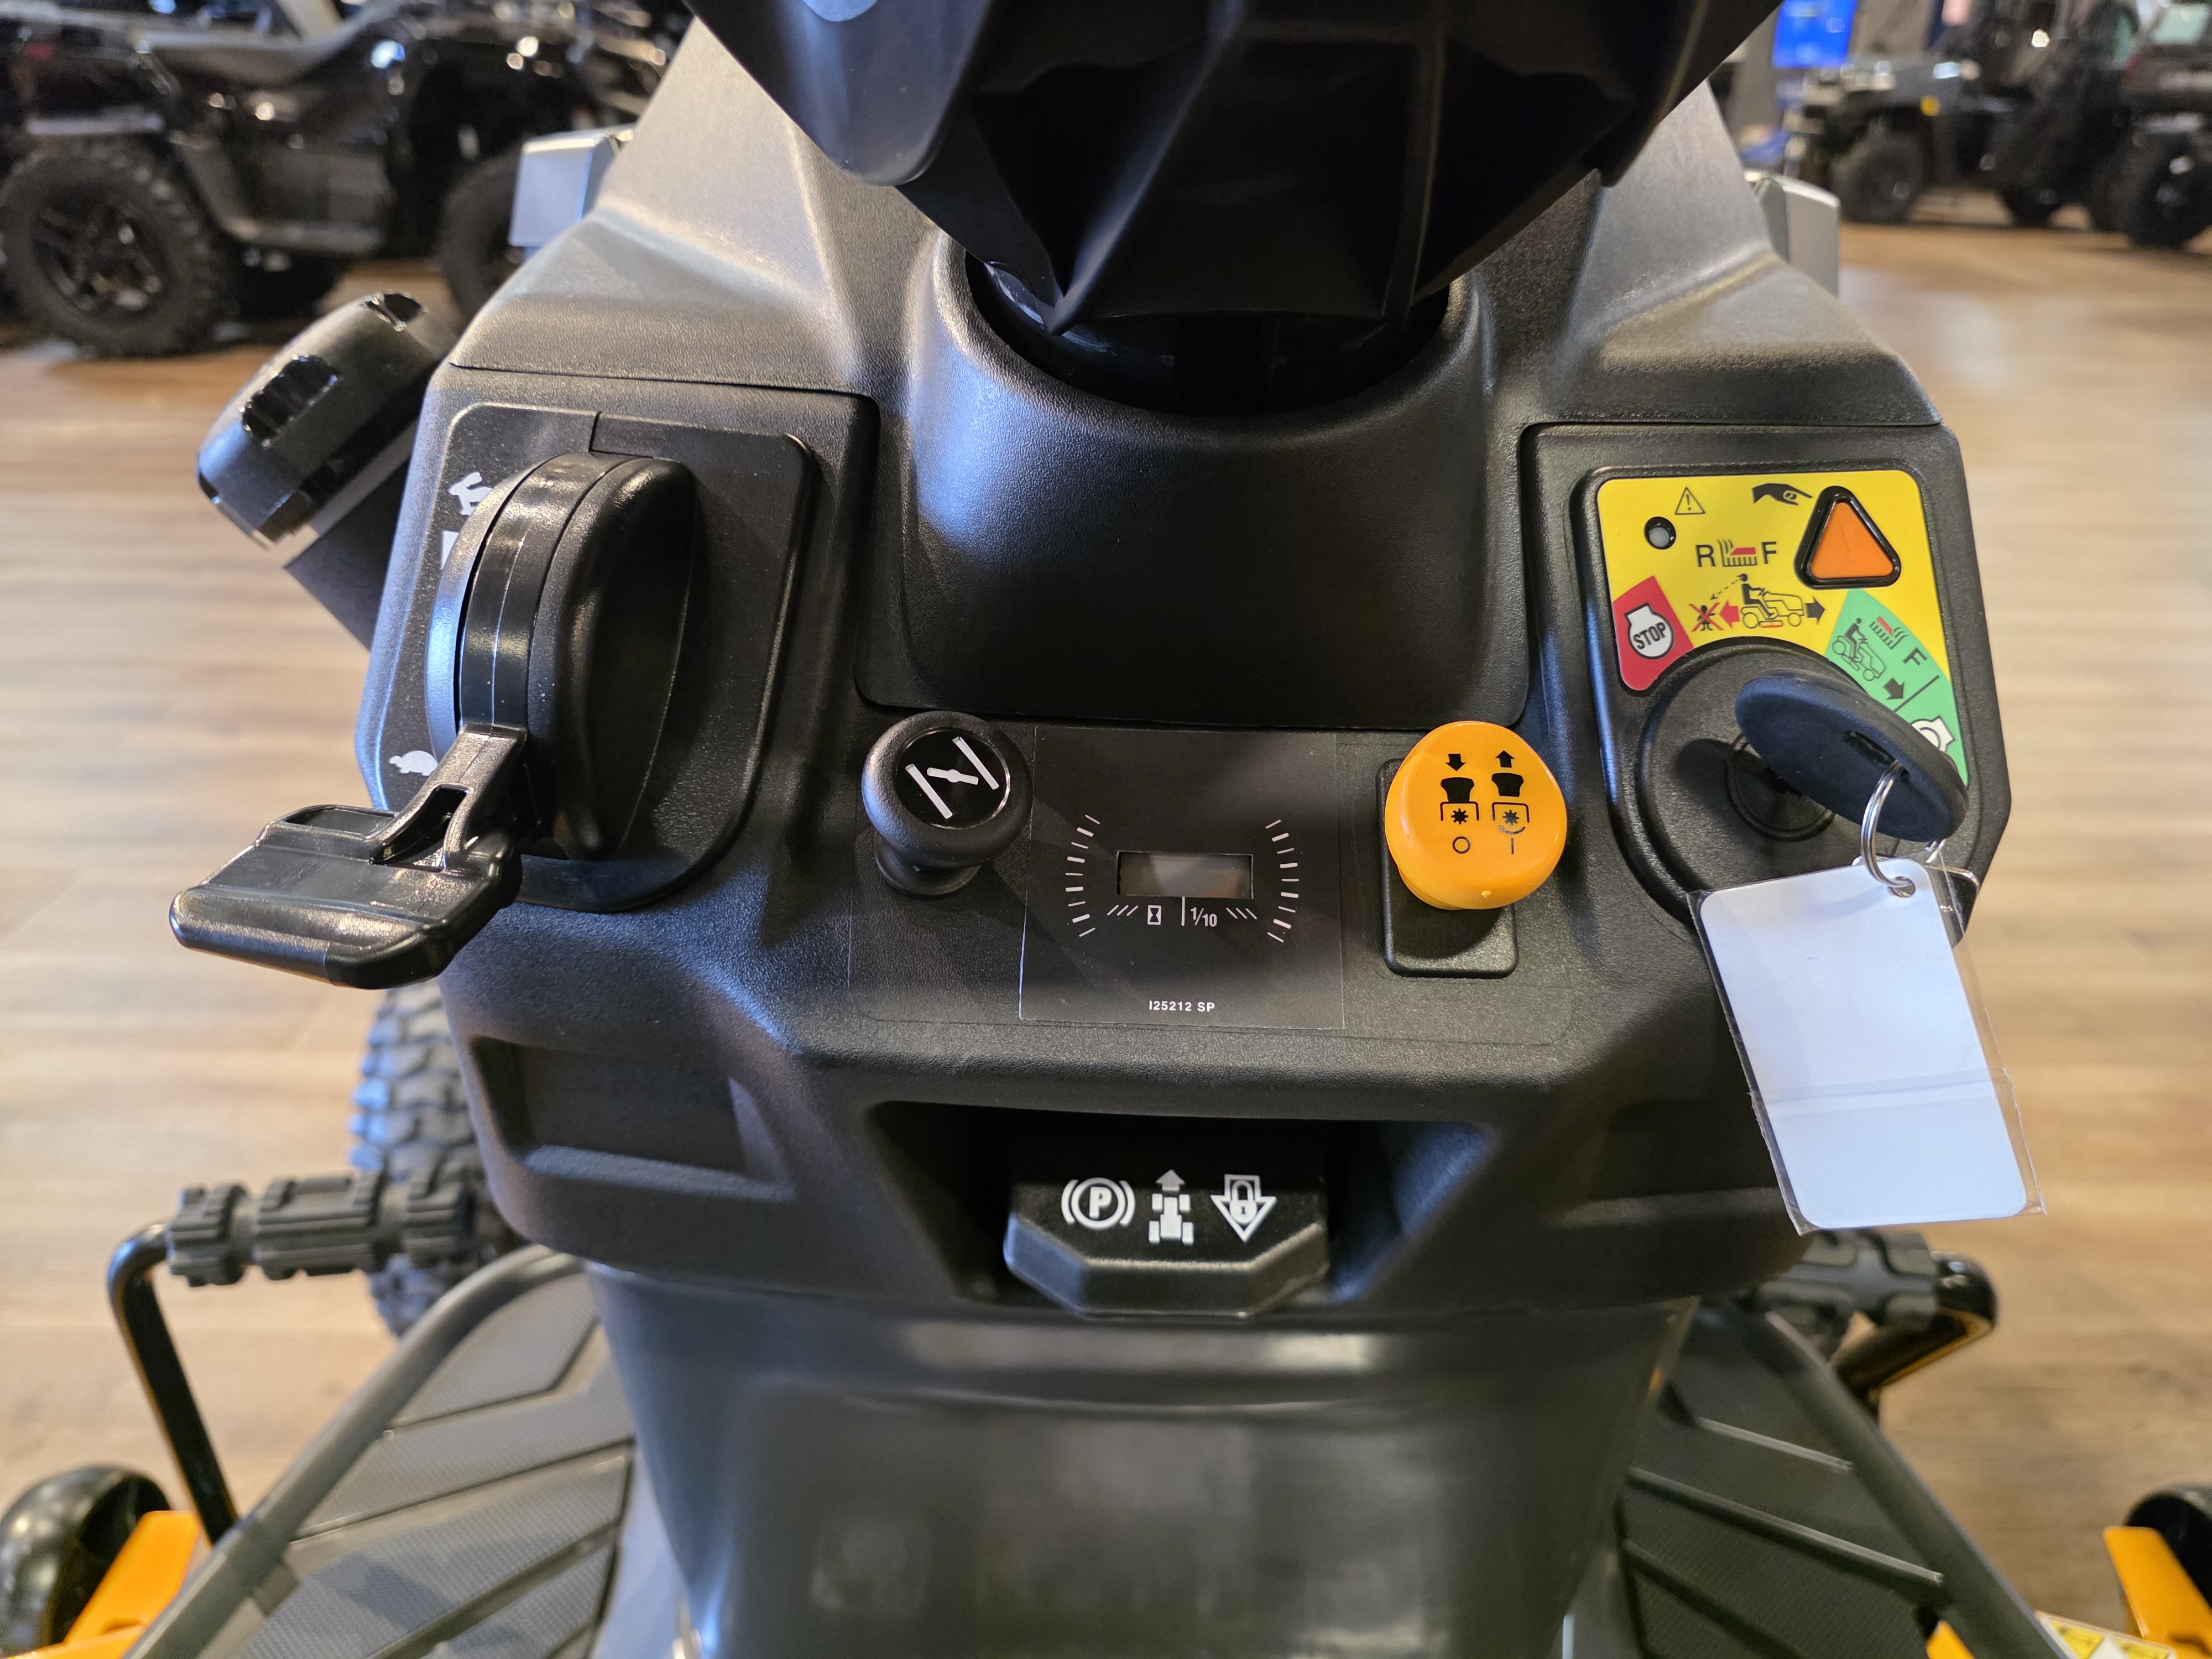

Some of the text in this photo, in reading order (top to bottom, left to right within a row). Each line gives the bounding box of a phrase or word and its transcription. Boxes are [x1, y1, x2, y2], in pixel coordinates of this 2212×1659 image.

[1695, 541, 1777, 568] R F
[1632, 622, 1666, 650] STOP
[1902, 647, 1927, 666] F
[1190, 906, 1218, 927] 1/10
[1197, 1001, 1215, 1013] SP
[1089, 1186, 1113, 1219] P
